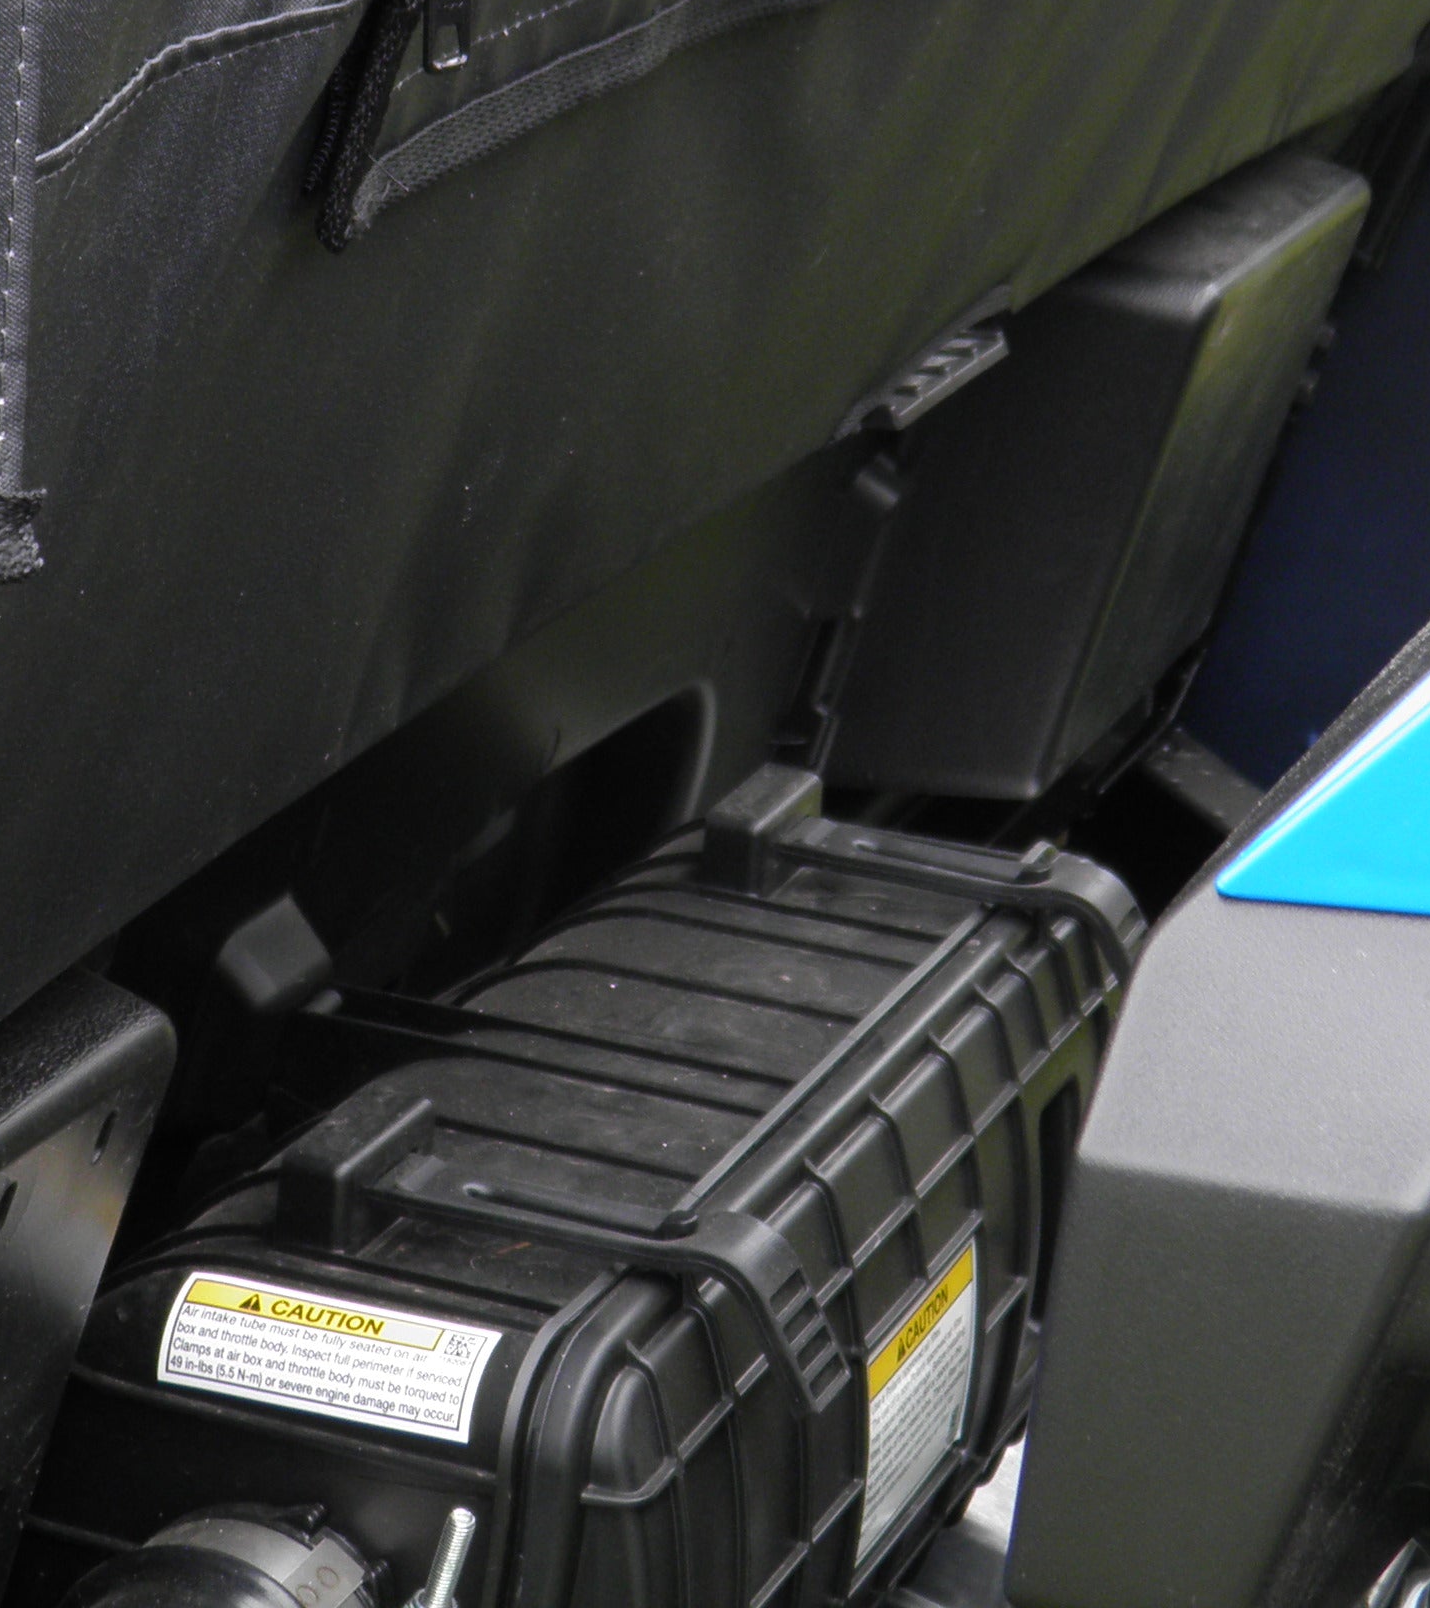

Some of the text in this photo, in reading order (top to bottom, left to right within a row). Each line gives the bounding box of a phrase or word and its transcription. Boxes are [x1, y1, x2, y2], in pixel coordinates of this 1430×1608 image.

[182, 1305, 199, 1316] Air
[201, 1310, 237, 1325] intake
[240, 1317, 266, 1331] tube
[270, 1324, 300, 1338] must
[303, 1330, 318, 1341] be
[322, 1333, 346, 1349] fully
[349, 1341, 392, 1356] seated
[394, 1349, 409, 1359] on
[413, 1353, 427, 1362] air
[271, 1300, 384, 1335] CAUTION
[906, 1284, 949, 1349] CAUTION
[173, 1337, 460, 1405] Clamps at air box and throttle body must be torqued to
[177, 1321, 196, 1334] box
[198, 1326, 219, 1339] and
[221, 1330, 258, 1347] throttle
[292, 1344, 331, 1362] Inspect
[334, 1352, 351, 1366] full
[407, 1367, 414, 1378] if
[170, 1355, 455, 1423] 49 in-lbs (5.5 N-m) or severe engine damage may occur.
